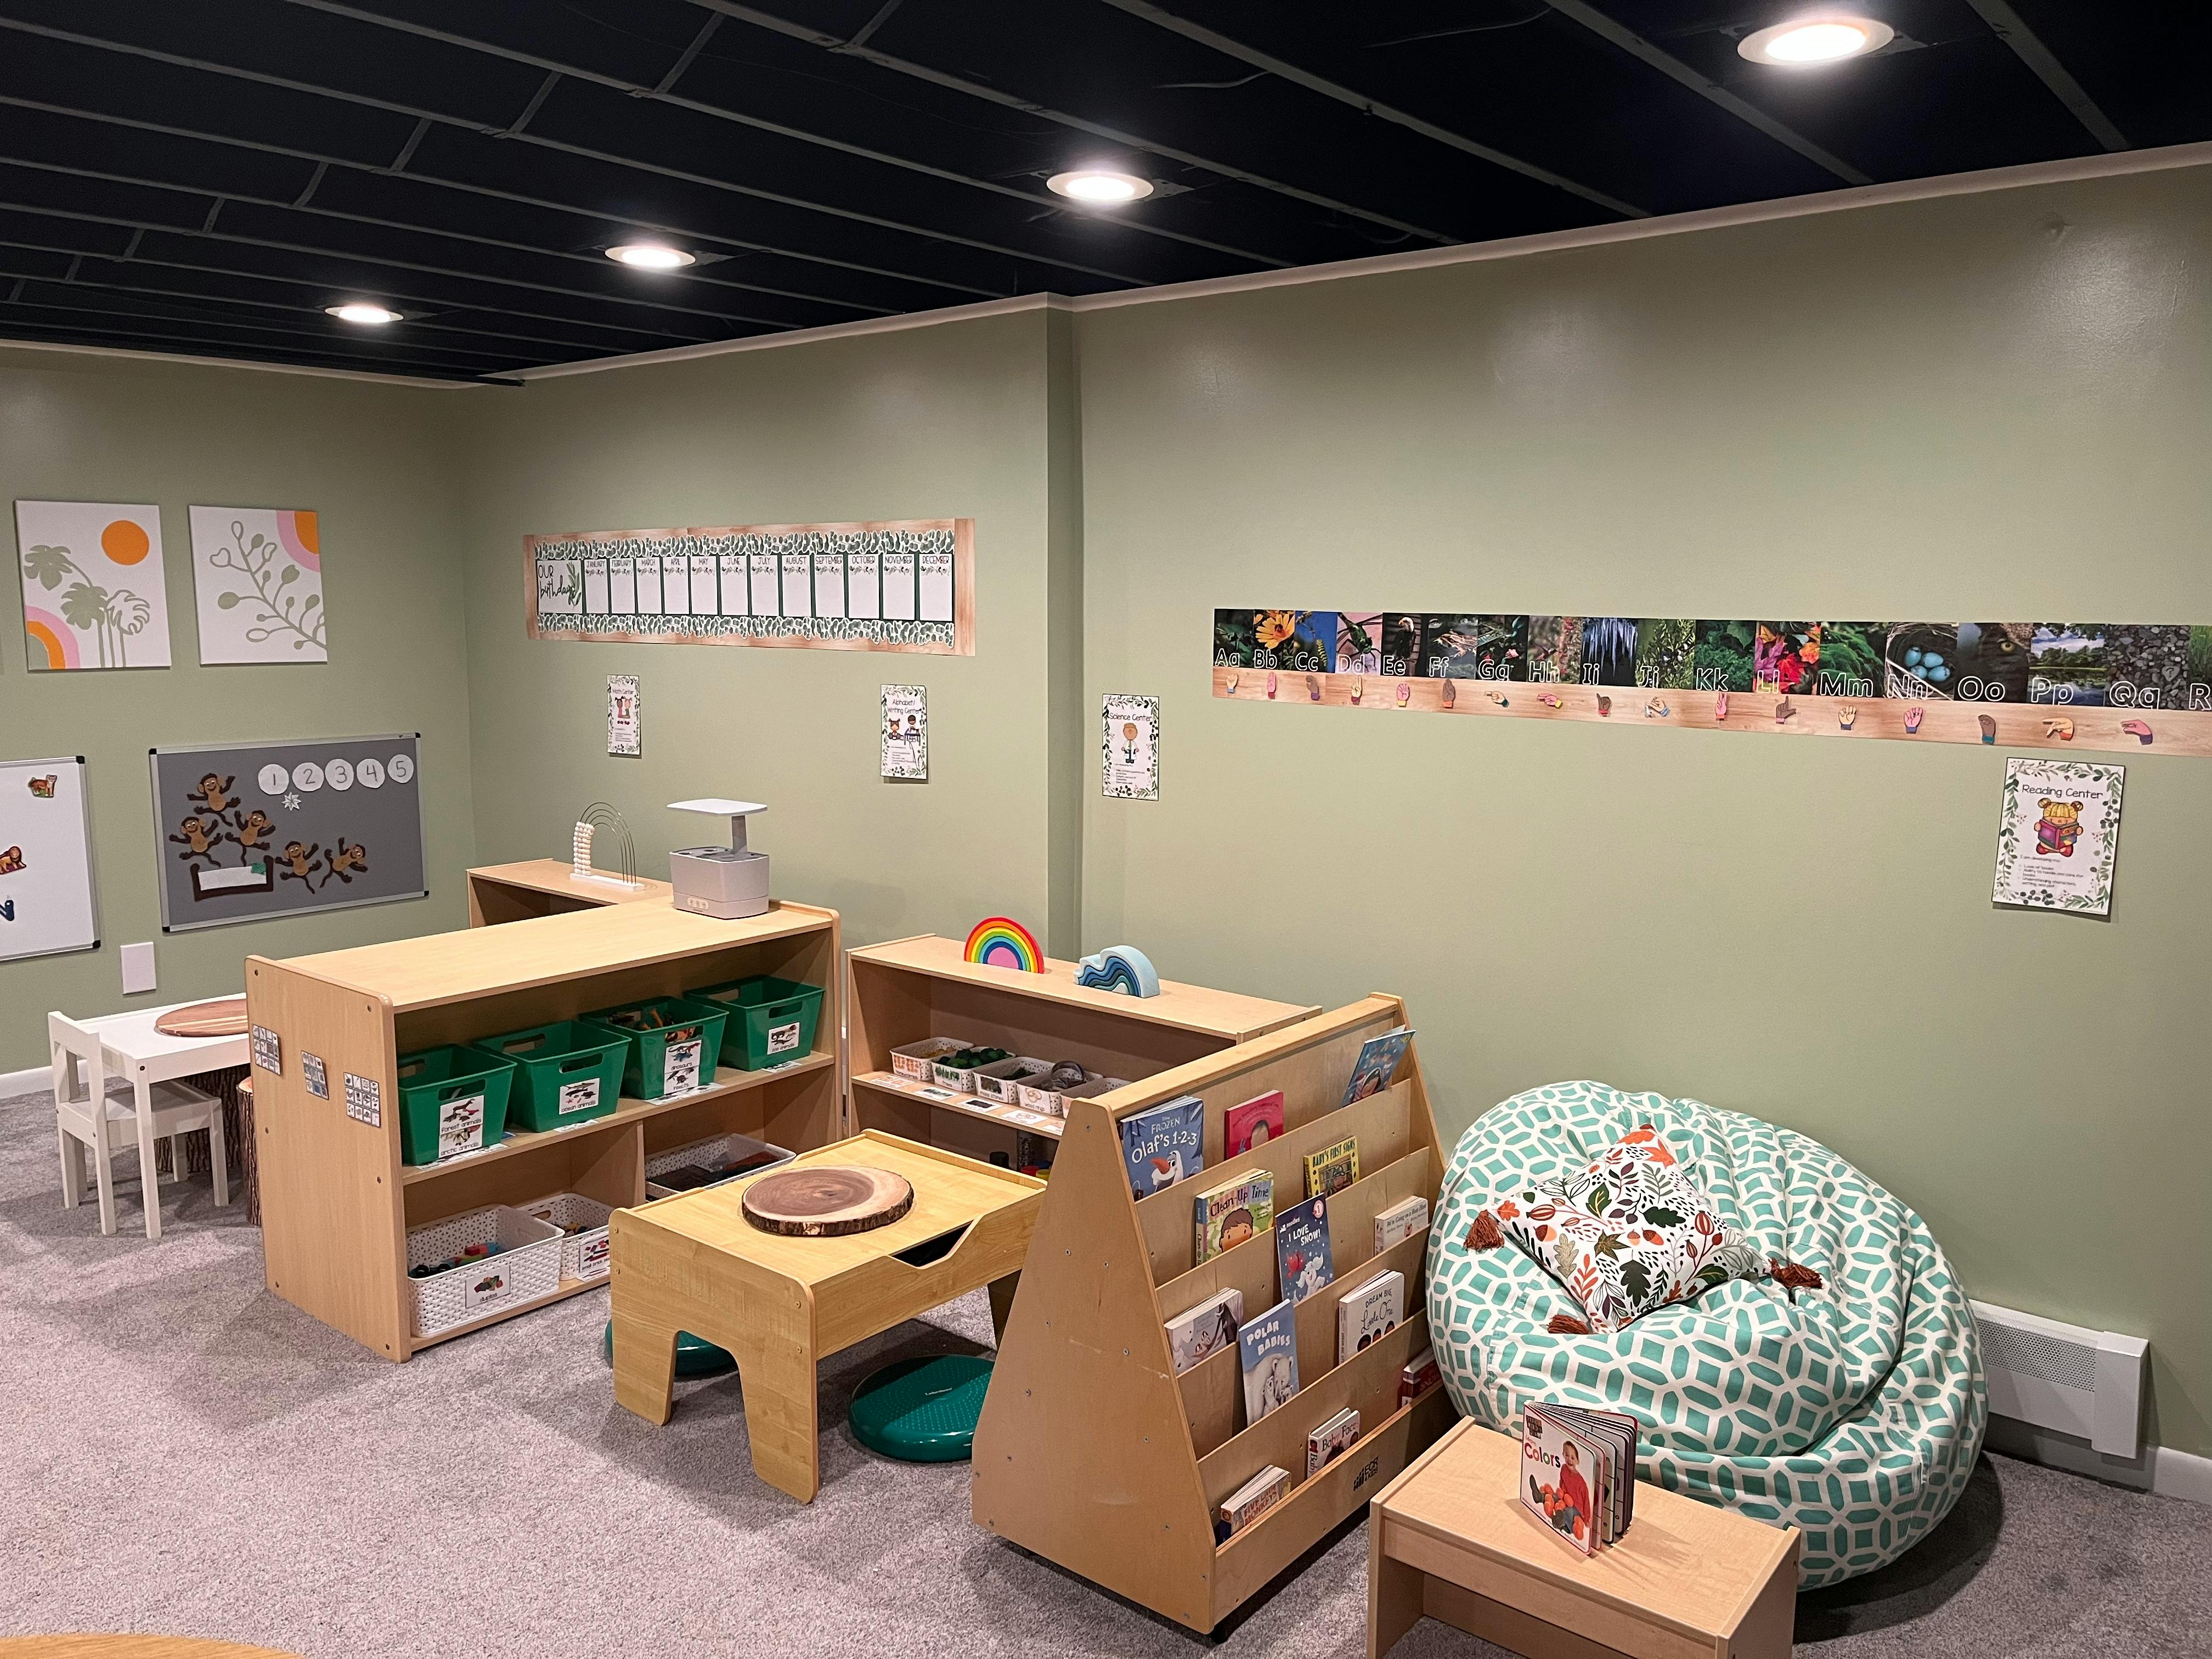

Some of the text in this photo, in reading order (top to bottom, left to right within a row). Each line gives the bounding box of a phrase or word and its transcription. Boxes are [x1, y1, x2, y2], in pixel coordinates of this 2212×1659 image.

[757, 557, 771, 565] JULY
[815, 556, 843, 565] SEPTEMBER
[852, 556, 875, 565] OCTOBER
[885, 556, 913, 565] NOVEMBER
[922, 556, 950, 565] DECEMBER
[538, 565, 554, 578] OUR
[1215, 648, 1240, 668] Aa
[1254, 649, 1277, 669] Bb
[1295, 652, 1318, 672] Cc
[1338, 653, 1364, 675] Dd
[1383, 656, 1407, 676] Ee
[1429, 657, 1449, 677] Ff
[1529, 661, 1560, 683] Hh
[1583, 663, 1599, 685] Ii
[1696, 668, 1729, 691] Kk
[1820, 672, 1874, 697] Mm
[1887, 674, 1928, 699] Nn
[1958, 676, 2005, 702] Oo
[2031, 678, 2073, 706] Pp
[273, 761, 407, 786] 1 2 3 4 5
[2022, 785, 2103, 799] Reading Center
[1151, 1116, 1180, 1135] FROZEN
[1132, 1131, 1197, 1163] Olaf's 1-2-3
[1330, 1144, 1342, 1160] FIRST
[1252, 1185, 1269, 1199] Time
[1289, 1224, 1310, 1242] I LOVE
[1301, 1228, 1321, 1246] SNOW!
[1365, 1289, 1392, 1308] DREAM BIG
[1246, 1321, 1279, 1346] POLAR
[1257, 1335, 1290, 1356] BABIES
[1322, 1433, 1340, 1452] Baby
[1525, 1442, 1561, 1468] Colors
[1244, 1498, 1259, 1518] FIVE
